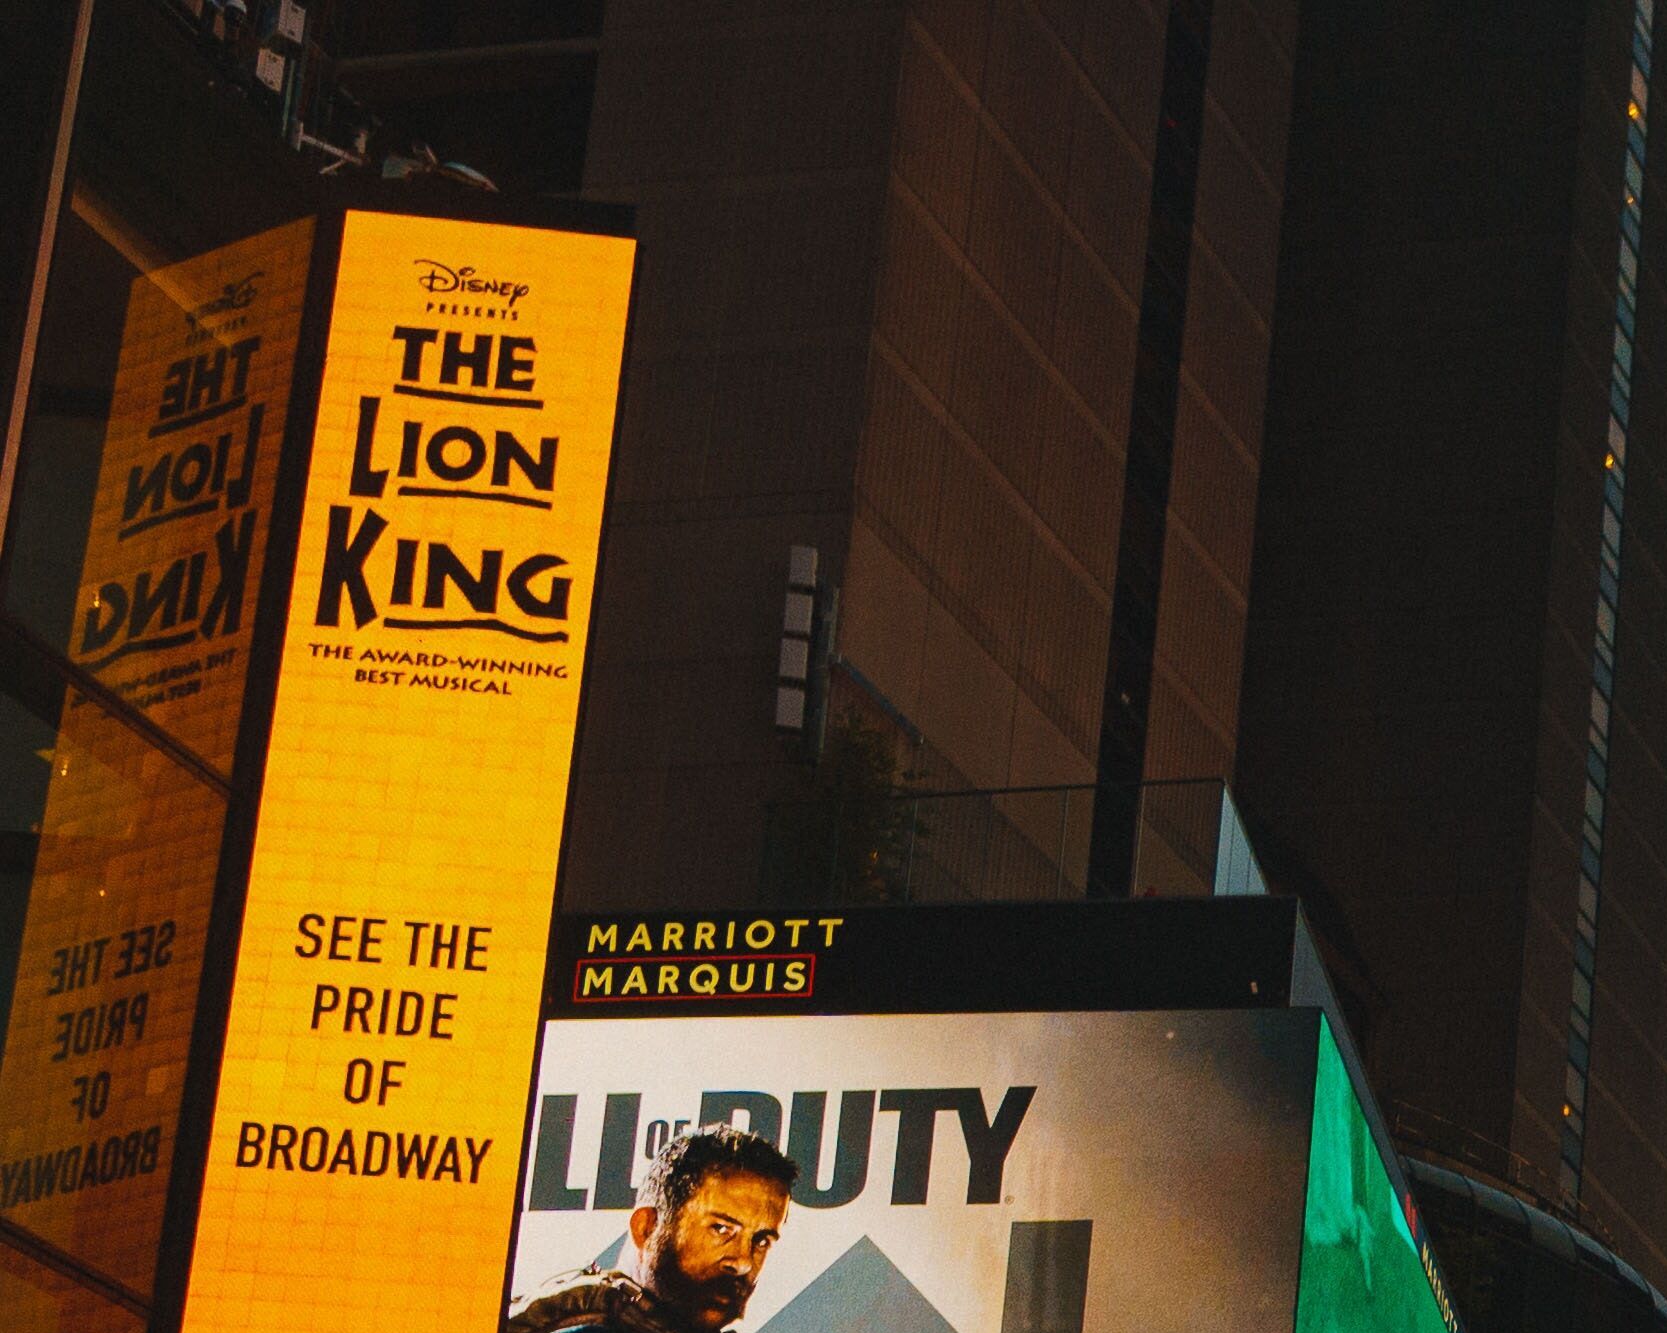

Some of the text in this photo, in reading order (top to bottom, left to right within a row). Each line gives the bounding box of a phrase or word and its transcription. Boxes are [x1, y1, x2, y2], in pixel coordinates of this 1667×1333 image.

[415, 258, 529, 305] Disney
[426, 302, 519, 321] PRESENTS
[392, 325, 538, 392] THE
[349, 396, 560, 499] LION
[314, 505, 573, 630] KING
[308, 643, 569, 679] THE AWARD-WINNING
[354, 669, 513, 696] BEST MUSICAL
[294, 914, 492, 971] SEE THE
[587, 918, 844, 953] MARRIOTT
[582, 962, 807, 996] MARQUIS
[311, 984, 458, 1040] PRIDE
[344, 1058, 406, 1106] OF
[236, 1121, 493, 1184] BROADWAY
